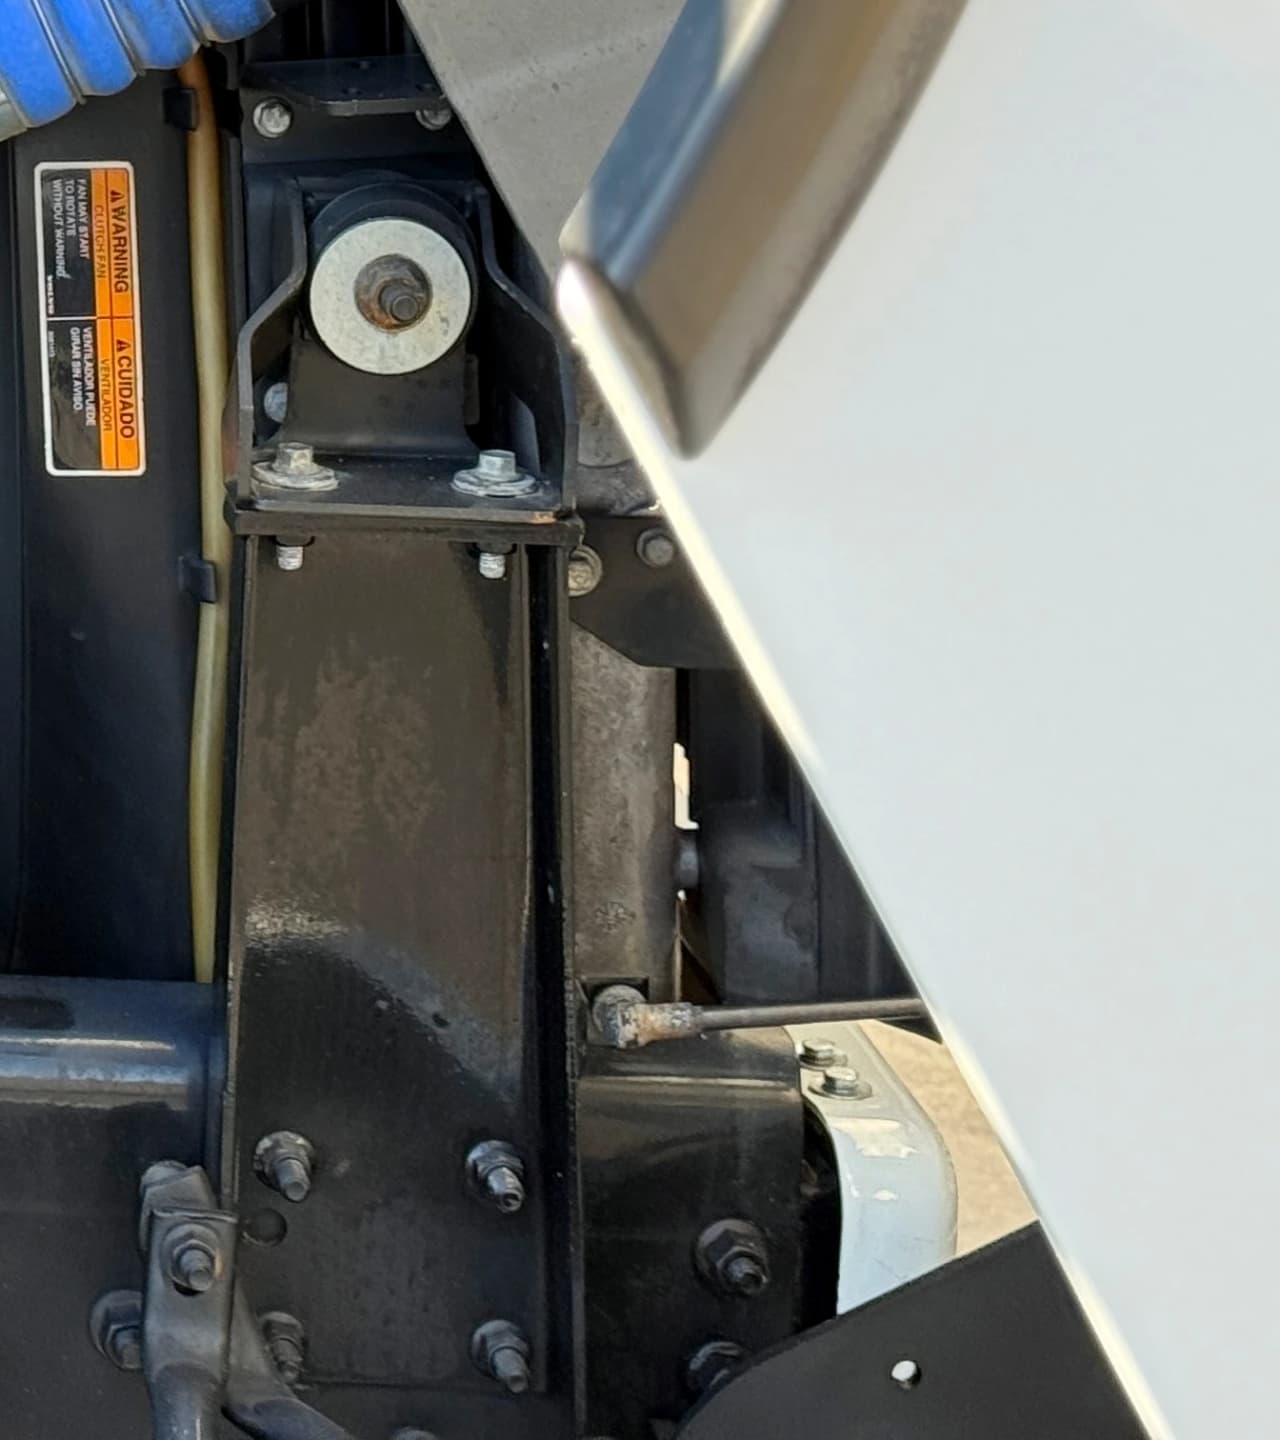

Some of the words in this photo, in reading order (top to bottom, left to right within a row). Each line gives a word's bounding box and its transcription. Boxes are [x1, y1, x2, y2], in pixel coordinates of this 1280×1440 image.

[52, 178, 65, 227] WITHOUT
[64, 179, 76, 194] TO
[77, 178, 89, 199] FAN
[65, 195, 78, 237] ROTATE
[78, 201, 90, 223] MAY
[95, 204, 107, 254] CLUTCH
[79, 225, 91, 260] START
[110, 205, 130, 294] WARNING
[96, 257, 108, 279] FAN
[70, 327, 82, 360] GIRAR
[82, 326, 96, 393] VENTILADOR
[72, 361, 83, 379] SIN
[85, 394, 97, 427] PUEDE
[99, 359, 114, 432] VENTILADOR
[117, 355, 136, 439] CUIDADO
